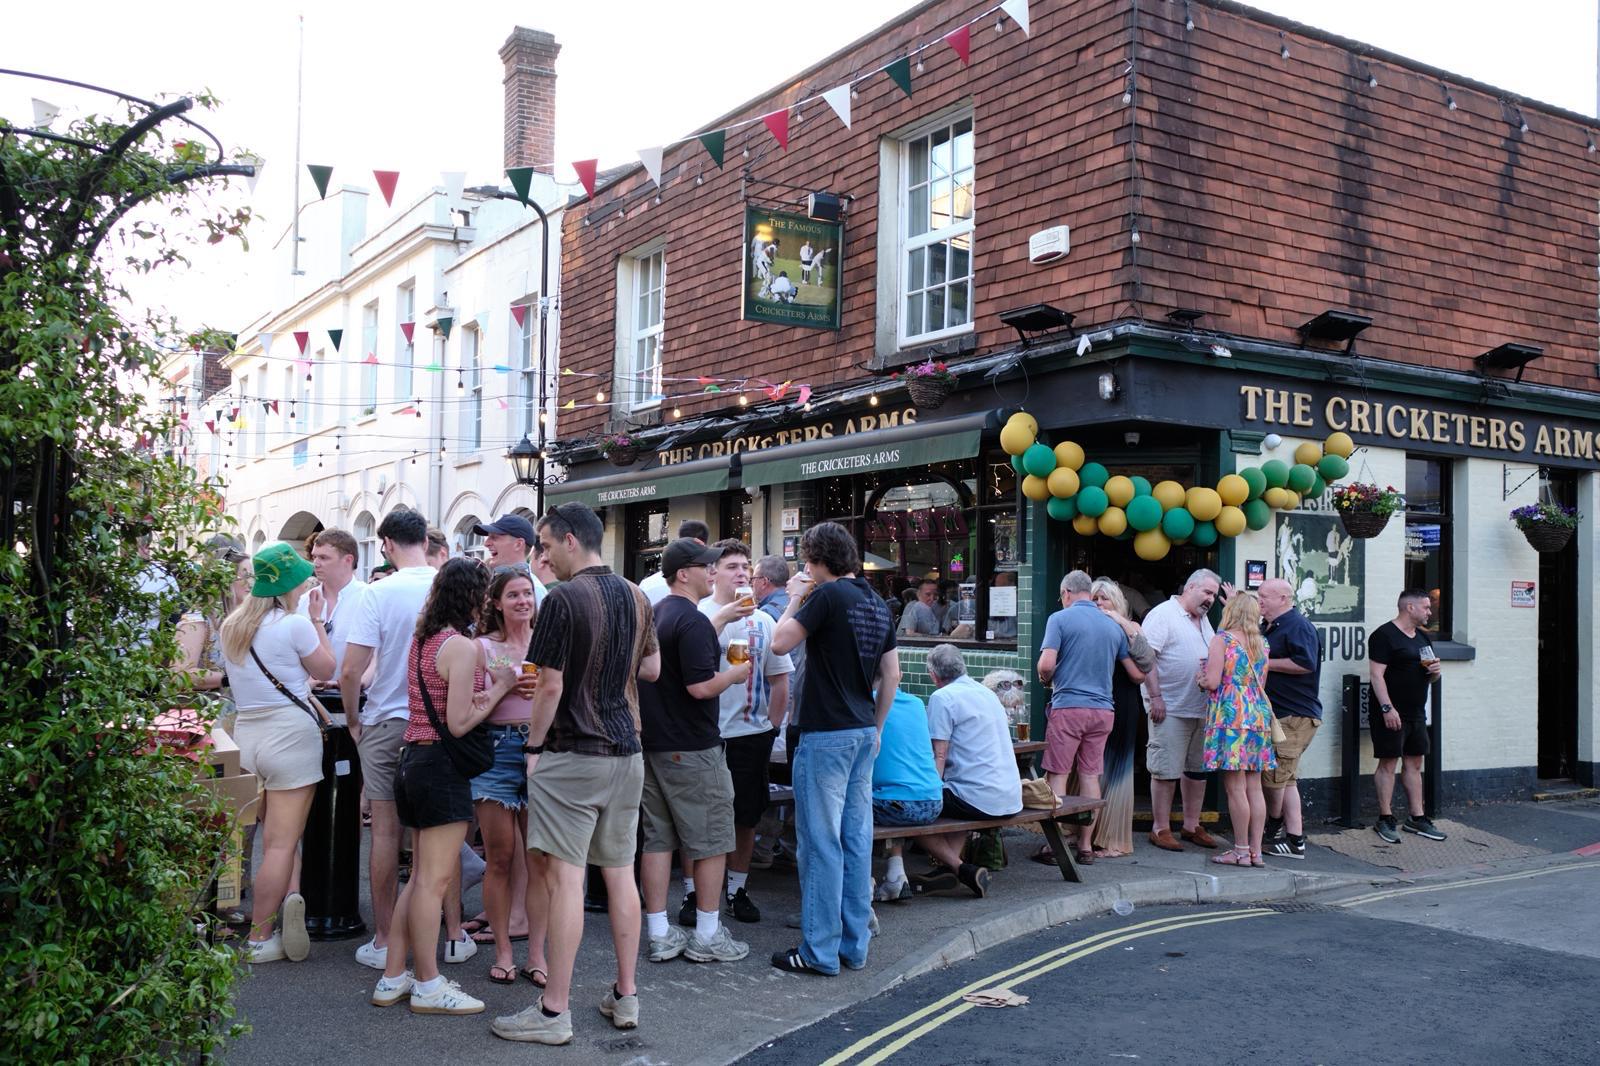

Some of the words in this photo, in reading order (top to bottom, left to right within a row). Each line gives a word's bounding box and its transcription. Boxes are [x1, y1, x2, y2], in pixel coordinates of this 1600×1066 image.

[768, 218, 785, 229] THE
[788, 222, 821, 234] FAMOUS
[755, 305, 806, 319] CRICKETERS
[807, 312, 831, 322] ARMS
[1241, 385, 1314, 427] THE
[1325, 397, 1526, 452] CRICKETERS
[801, 461, 817, 475] THE
[818, 454, 871, 472] CRICKETERS
[872, 450, 900, 465] ARMS
[598, 492, 608, 502] THE
[608, 487, 639, 501] CRICKETERS
[640, 485, 657, 497] ARMS
[1330, 626, 1366, 661] PUB
